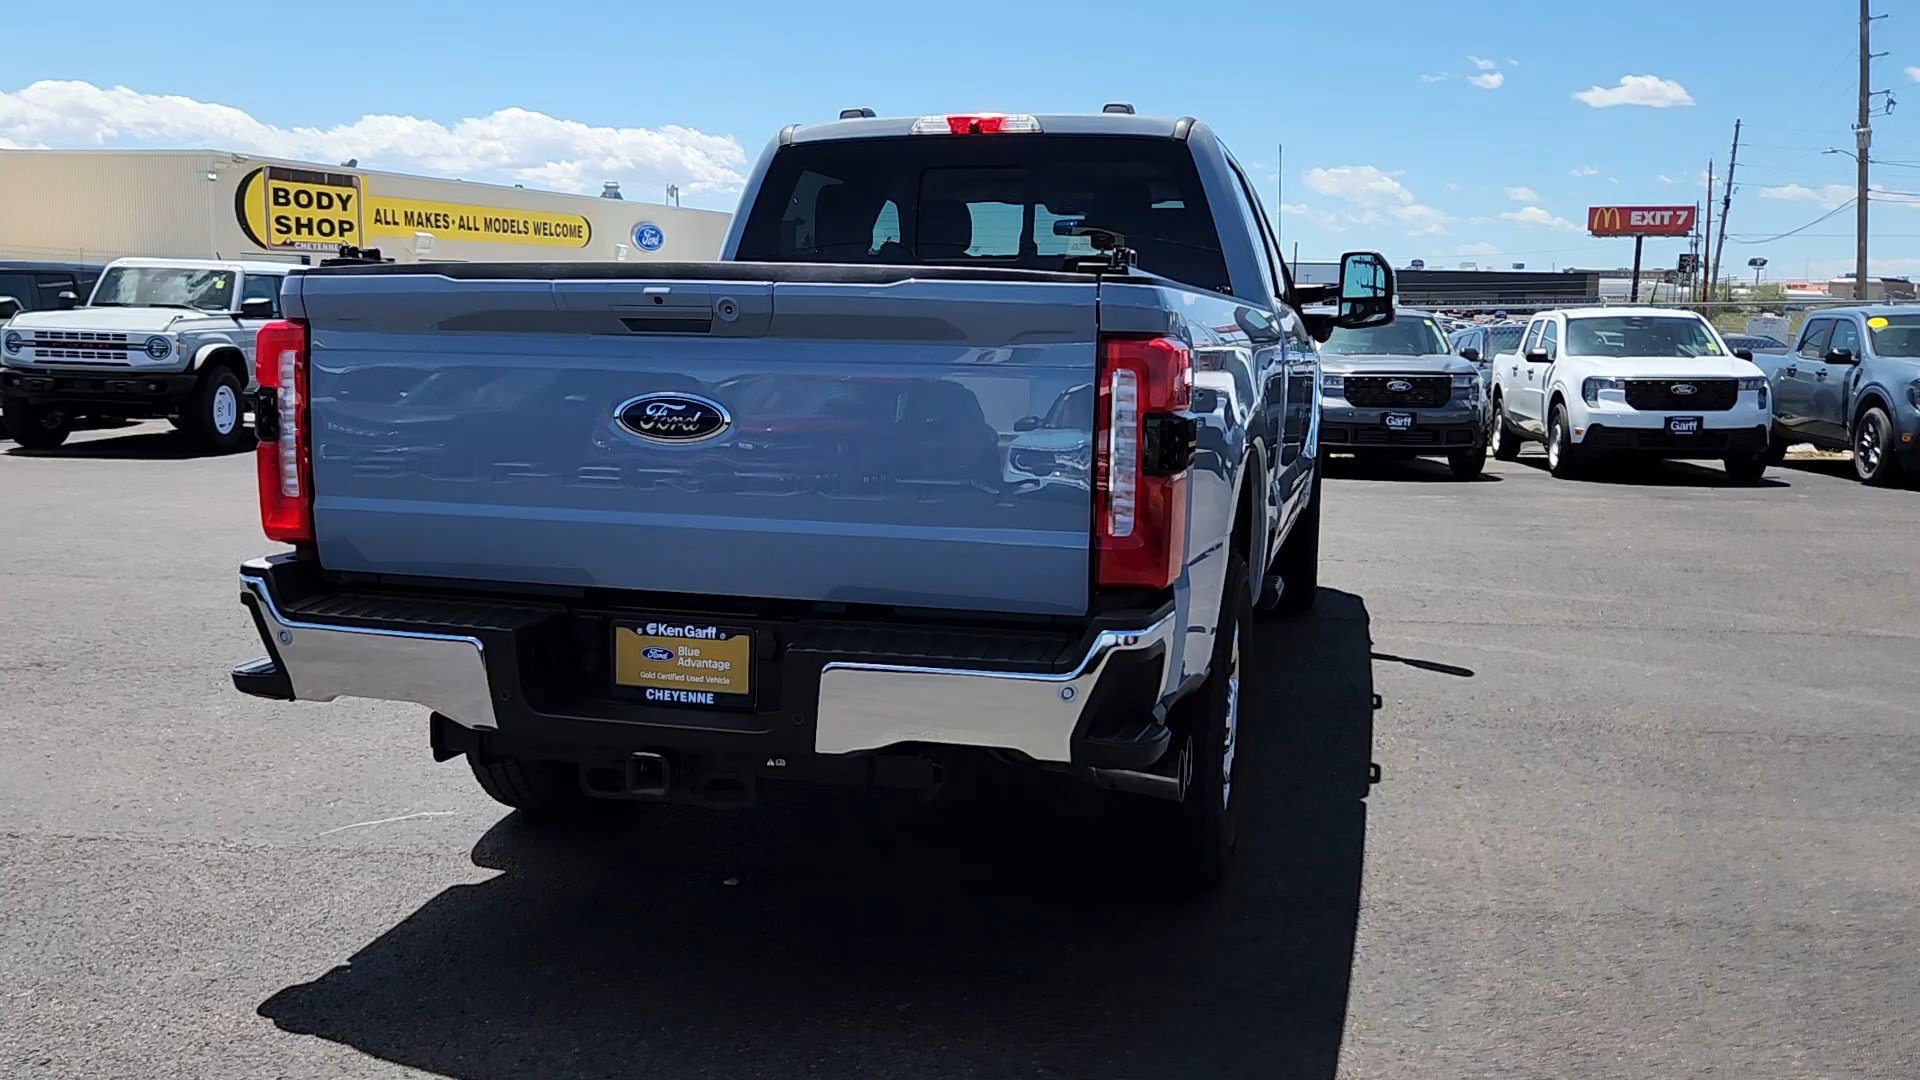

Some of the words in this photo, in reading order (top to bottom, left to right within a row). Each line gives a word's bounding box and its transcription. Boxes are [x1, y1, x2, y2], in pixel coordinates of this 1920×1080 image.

[272, 186, 353, 212] BODY
[373, 208, 400, 227] ALL
[404, 210, 450, 230] MAKES
[457, 214, 480, 232] ALL
[484, 216, 530, 236] MODELS
[533, 220, 584, 239] WELCOME
[1630, 210, 1673, 226] EXIT
[1676, 210, 1689, 225] 7
[274, 215, 355, 238] SHOP
[640, 402, 702, 432] Ford
[1385, 415, 1412, 427] Garff
[1670, 420, 1698, 431] Garff
[658, 623, 683, 637] Ken
[684, 625, 717, 639] Garff
[678, 645, 701, 657] Blue
[677, 657, 731, 671] Advantage
[640, 671, 656, 679] Gold
[657, 672, 684, 682] Certified
[686, 674, 704, 682] Used
[705, 676, 731, 685] Vehicle
[645, 688, 715, 704] CHEYENNE
